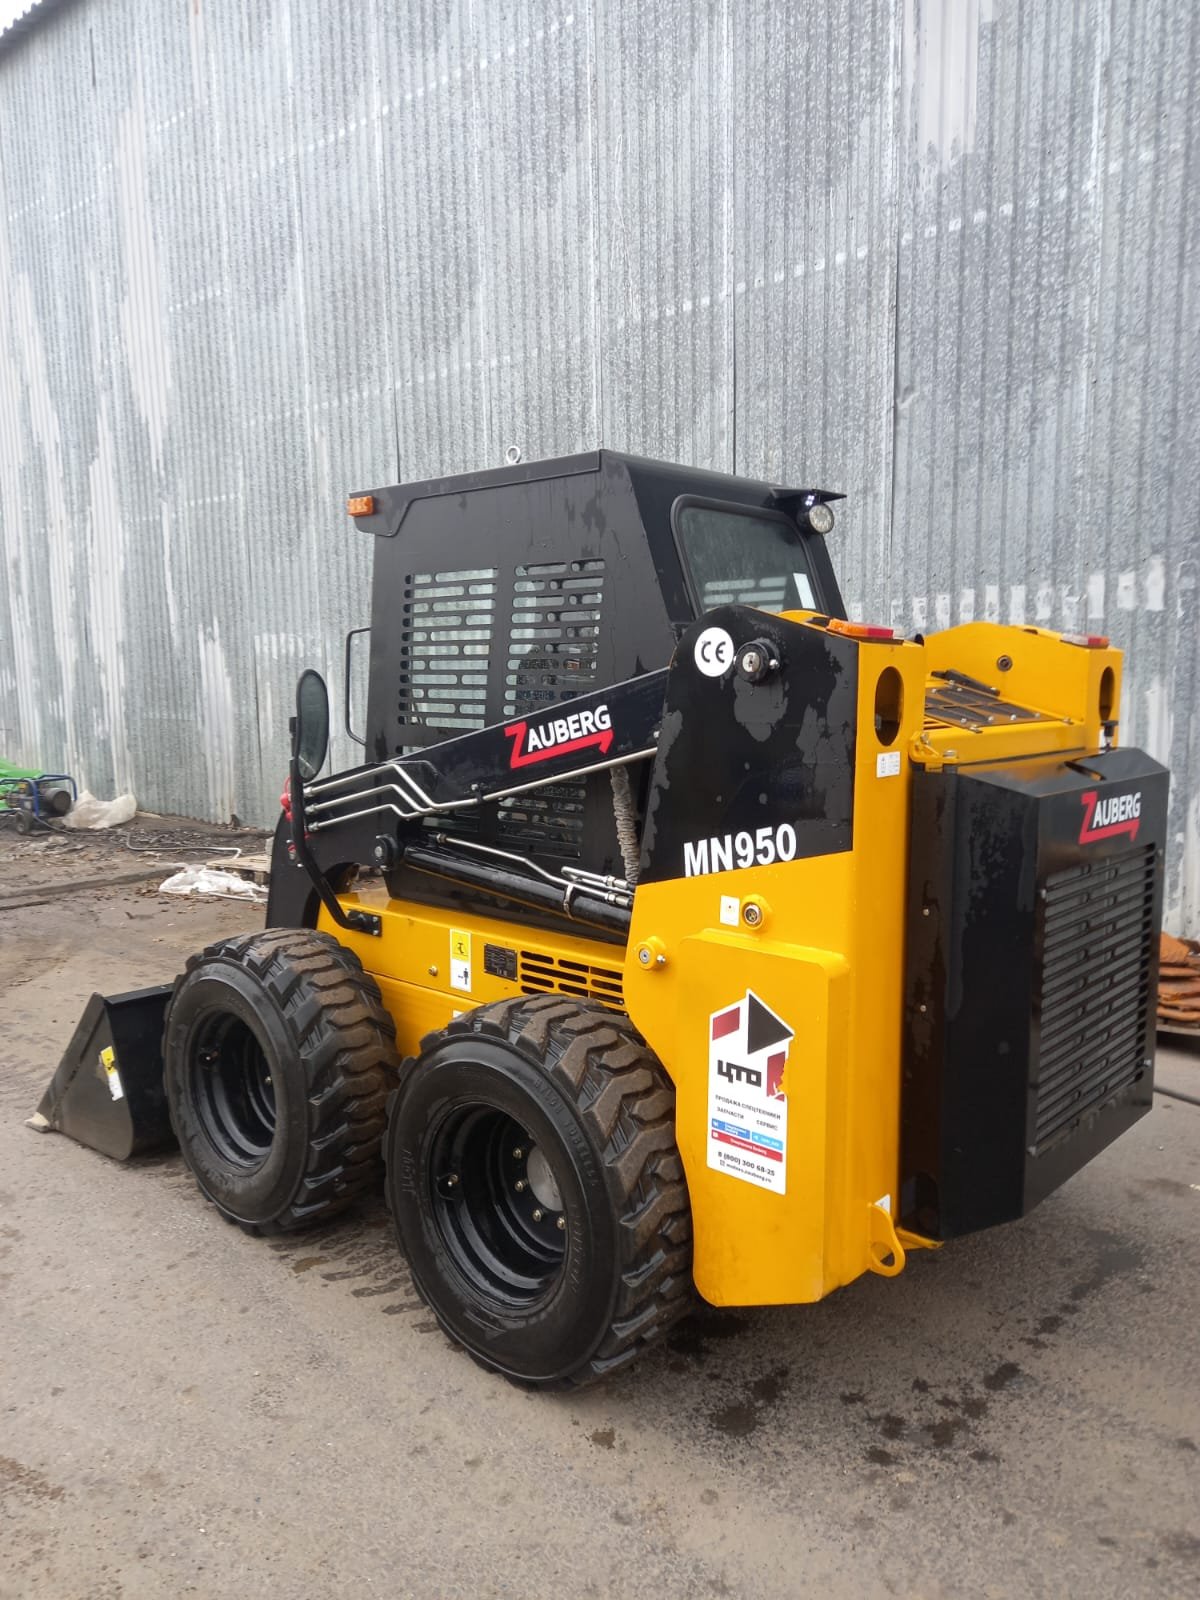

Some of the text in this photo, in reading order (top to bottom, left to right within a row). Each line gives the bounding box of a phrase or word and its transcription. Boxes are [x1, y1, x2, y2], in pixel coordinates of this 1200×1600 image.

[700, 640, 726, 664] CE
[504, 705, 614, 770] ZAUBERG
[1078, 791, 1142, 846] ZAUBERG
[683, 823, 798, 878] MN950
[717, 1059, 762, 1088] ЦТО
[715, 1094, 741, 1108] ПРОДАЖА
[716, 1106, 744, 1119] ЗАПЧАСТИ
[756, 1119, 778, 1131] СЕРВИС
[723, 1153, 741, 1165] (800)
[742, 1160, 755, 1169] 300
